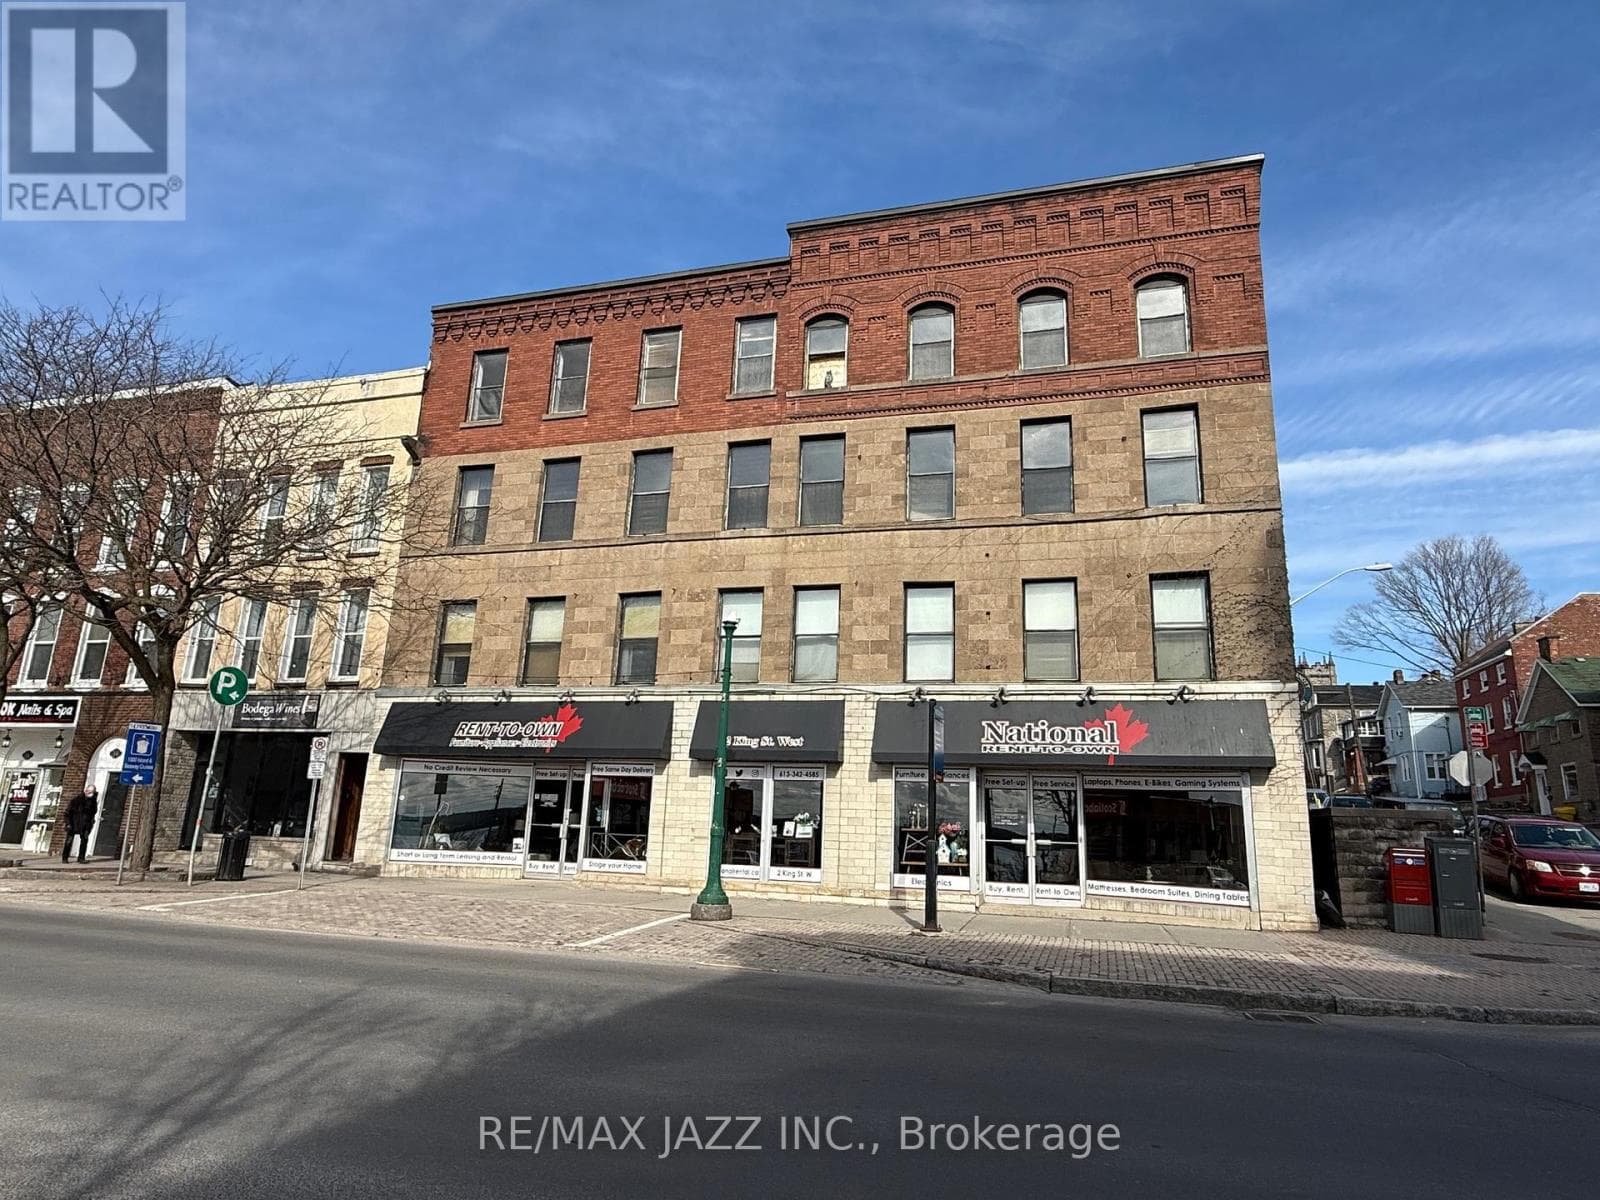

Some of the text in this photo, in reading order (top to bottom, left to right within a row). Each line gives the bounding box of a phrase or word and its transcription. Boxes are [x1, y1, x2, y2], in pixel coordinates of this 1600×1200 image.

[17, 703, 41, 716] Nails
[43, 704, 52, 715] &
[54, 704, 74, 719] Spa
[241, 701, 301, 717] Bodega Wines
[454, 721, 563, 737] RENT-TO-OWN
[981, 720, 1120, 745] National
[732, 736, 760, 748] King
[760, 736, 775, 747] St.
[777, 736, 805, 747] West
[981, 744, 1120, 755] RENT-TO-OWN
[423, 763, 513, 775] No Credit Review Necessary
[621, 766, 632, 774] Day
[633, 767, 655, 775] Delivery
[896, 770, 926, 778] Furniture
[1002, 779, 1026, 787] Set-up
[1050, 780, 1075, 788] Service
[1174, 780, 1206, 789] Gaming
[1207, 780, 1241, 789] Systems
[588, 861, 606, 869] Stage
[782, 870, 796, 878] King
[911, 877, 952, 887] Elecnics
[1036, 887, 1051, 895] Rent
[1063, 888, 1080, 896] Own
[1130, 886, 1166, 895] Bedroom
[1194, 890, 1221, 901] Dining
[1222, 893, 1249, 901] Tables
